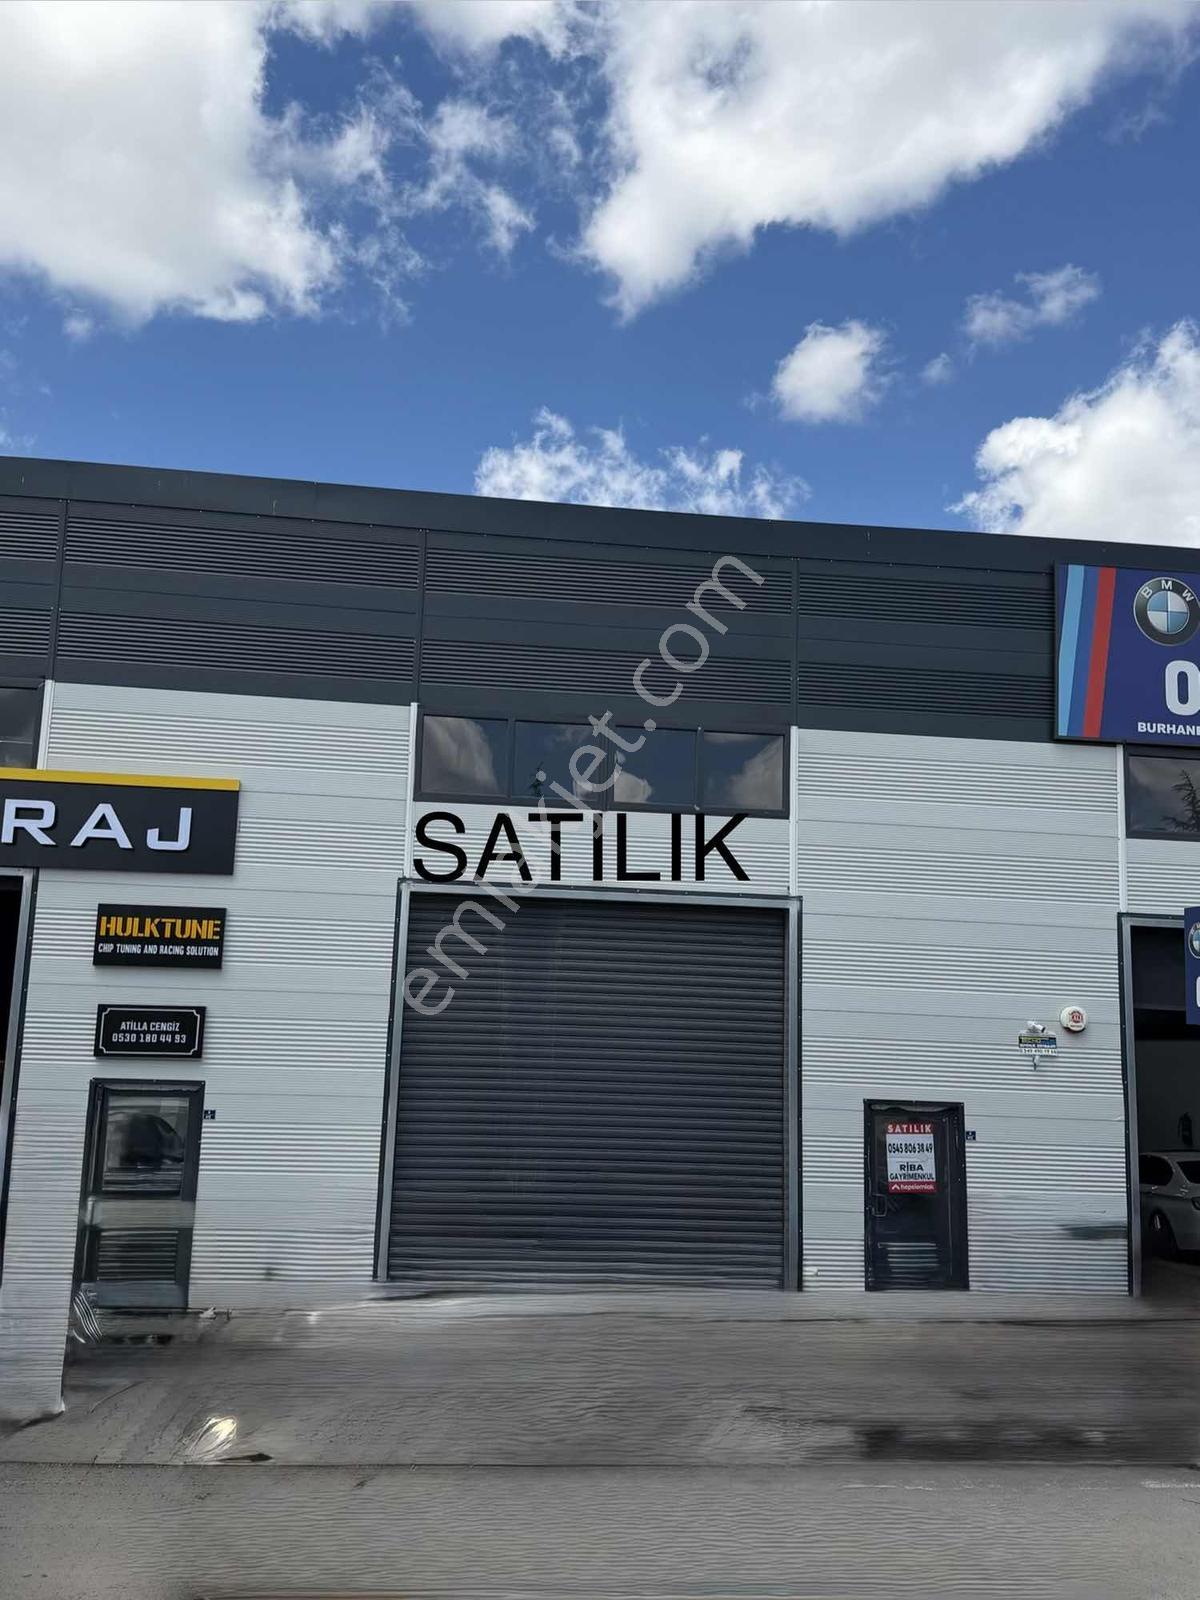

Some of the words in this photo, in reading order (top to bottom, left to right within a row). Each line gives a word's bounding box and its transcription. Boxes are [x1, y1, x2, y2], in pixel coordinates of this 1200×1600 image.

[1140, 579, 1195, 602] BMW
[1, 798, 193, 851] RAJ
[99, 916, 221, 940] HULKTUNE
[98, 943, 114, 953] CHIP
[116, 944, 141, 954] TUNING
[143, 944, 158, 955] AND
[159, 945, 184, 956] RACING
[186, 946, 219, 957] SOLUTION
[112, 1033, 136, 1042] 0530
[139, 1033, 156, 1043] 180
[159, 1034, 172, 1043] 44
[887, 1124, 931, 1132] SATILIK
